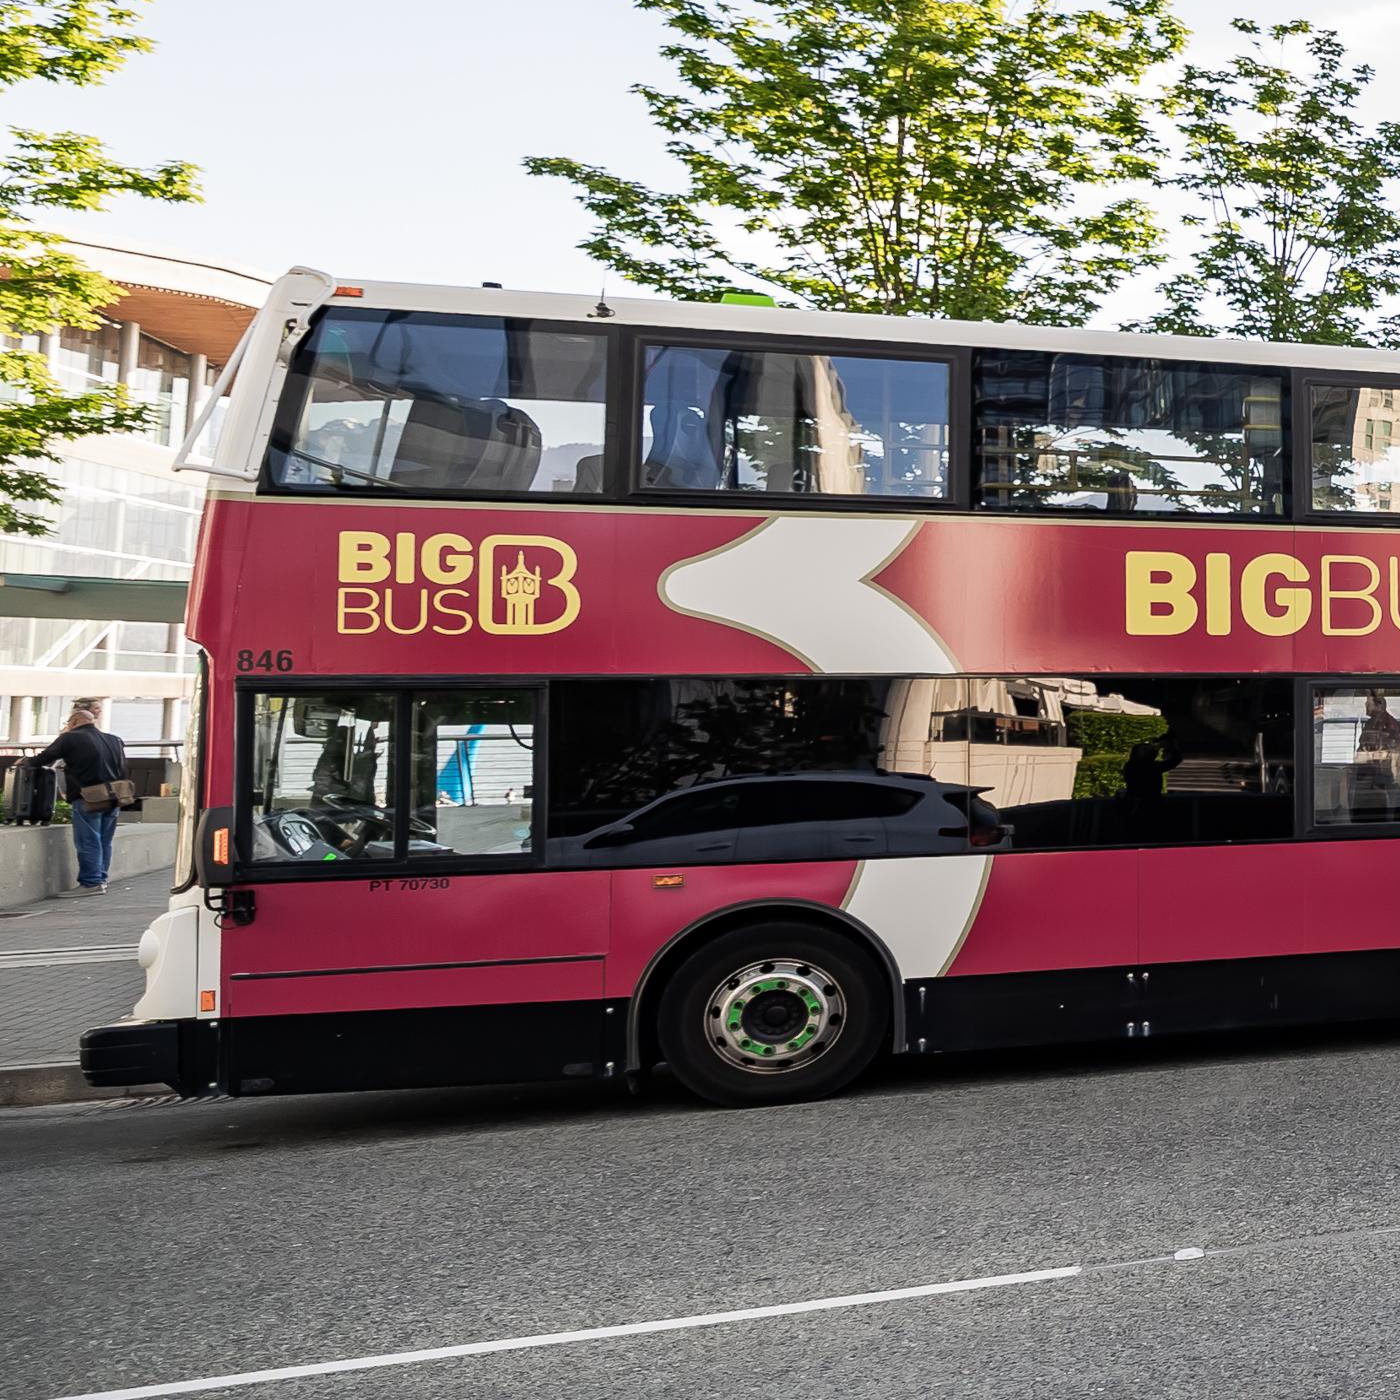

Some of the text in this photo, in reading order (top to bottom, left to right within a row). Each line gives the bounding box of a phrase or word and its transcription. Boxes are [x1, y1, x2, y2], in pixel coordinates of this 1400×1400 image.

[338, 531, 474, 584] BIG
[337, 587, 473, 634] BUS
[236, 649, 293, 673] 846
[369, 878, 450, 891] PT 70730
